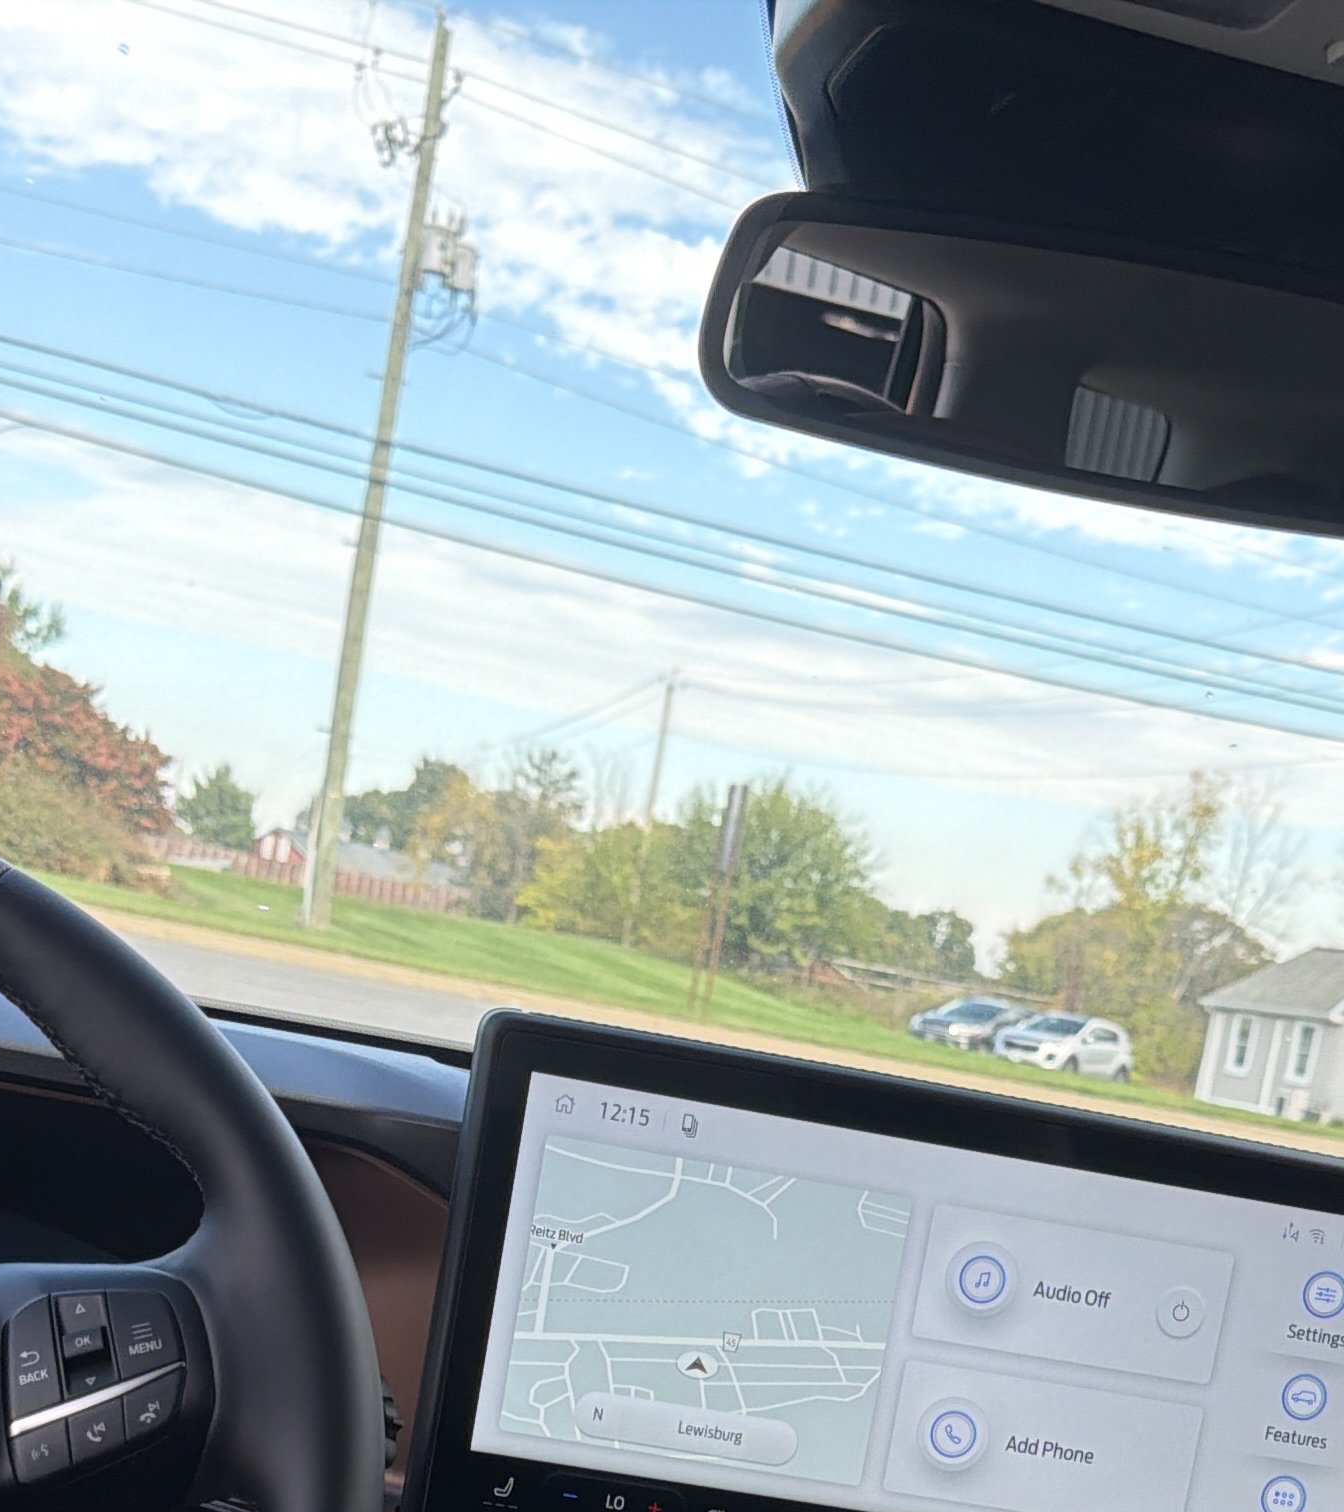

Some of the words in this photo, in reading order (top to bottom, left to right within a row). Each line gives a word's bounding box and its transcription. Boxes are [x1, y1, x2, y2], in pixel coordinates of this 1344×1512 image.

[600, 1101, 650, 1127] 12:15
[558, 1229, 584, 1244] Blvd
[1033, 1280, 1083, 1305] Audio
[1085, 1289, 1112, 1309] Off
[75, 1336, 91, 1348] OK
[128, 1339, 162, 1356] MENU
[18, 1369, 49, 1386] BACK
[592, 1406, 604, 1421] N
[677, 1420, 743, 1446] Lewisburg
[1264, 1426, 1328, 1450] Features
[1005, 1434, 1040, 1458] Add
[1042, 1442, 1095, 1465] Phone
[605, 1494, 625, 1511] LO
